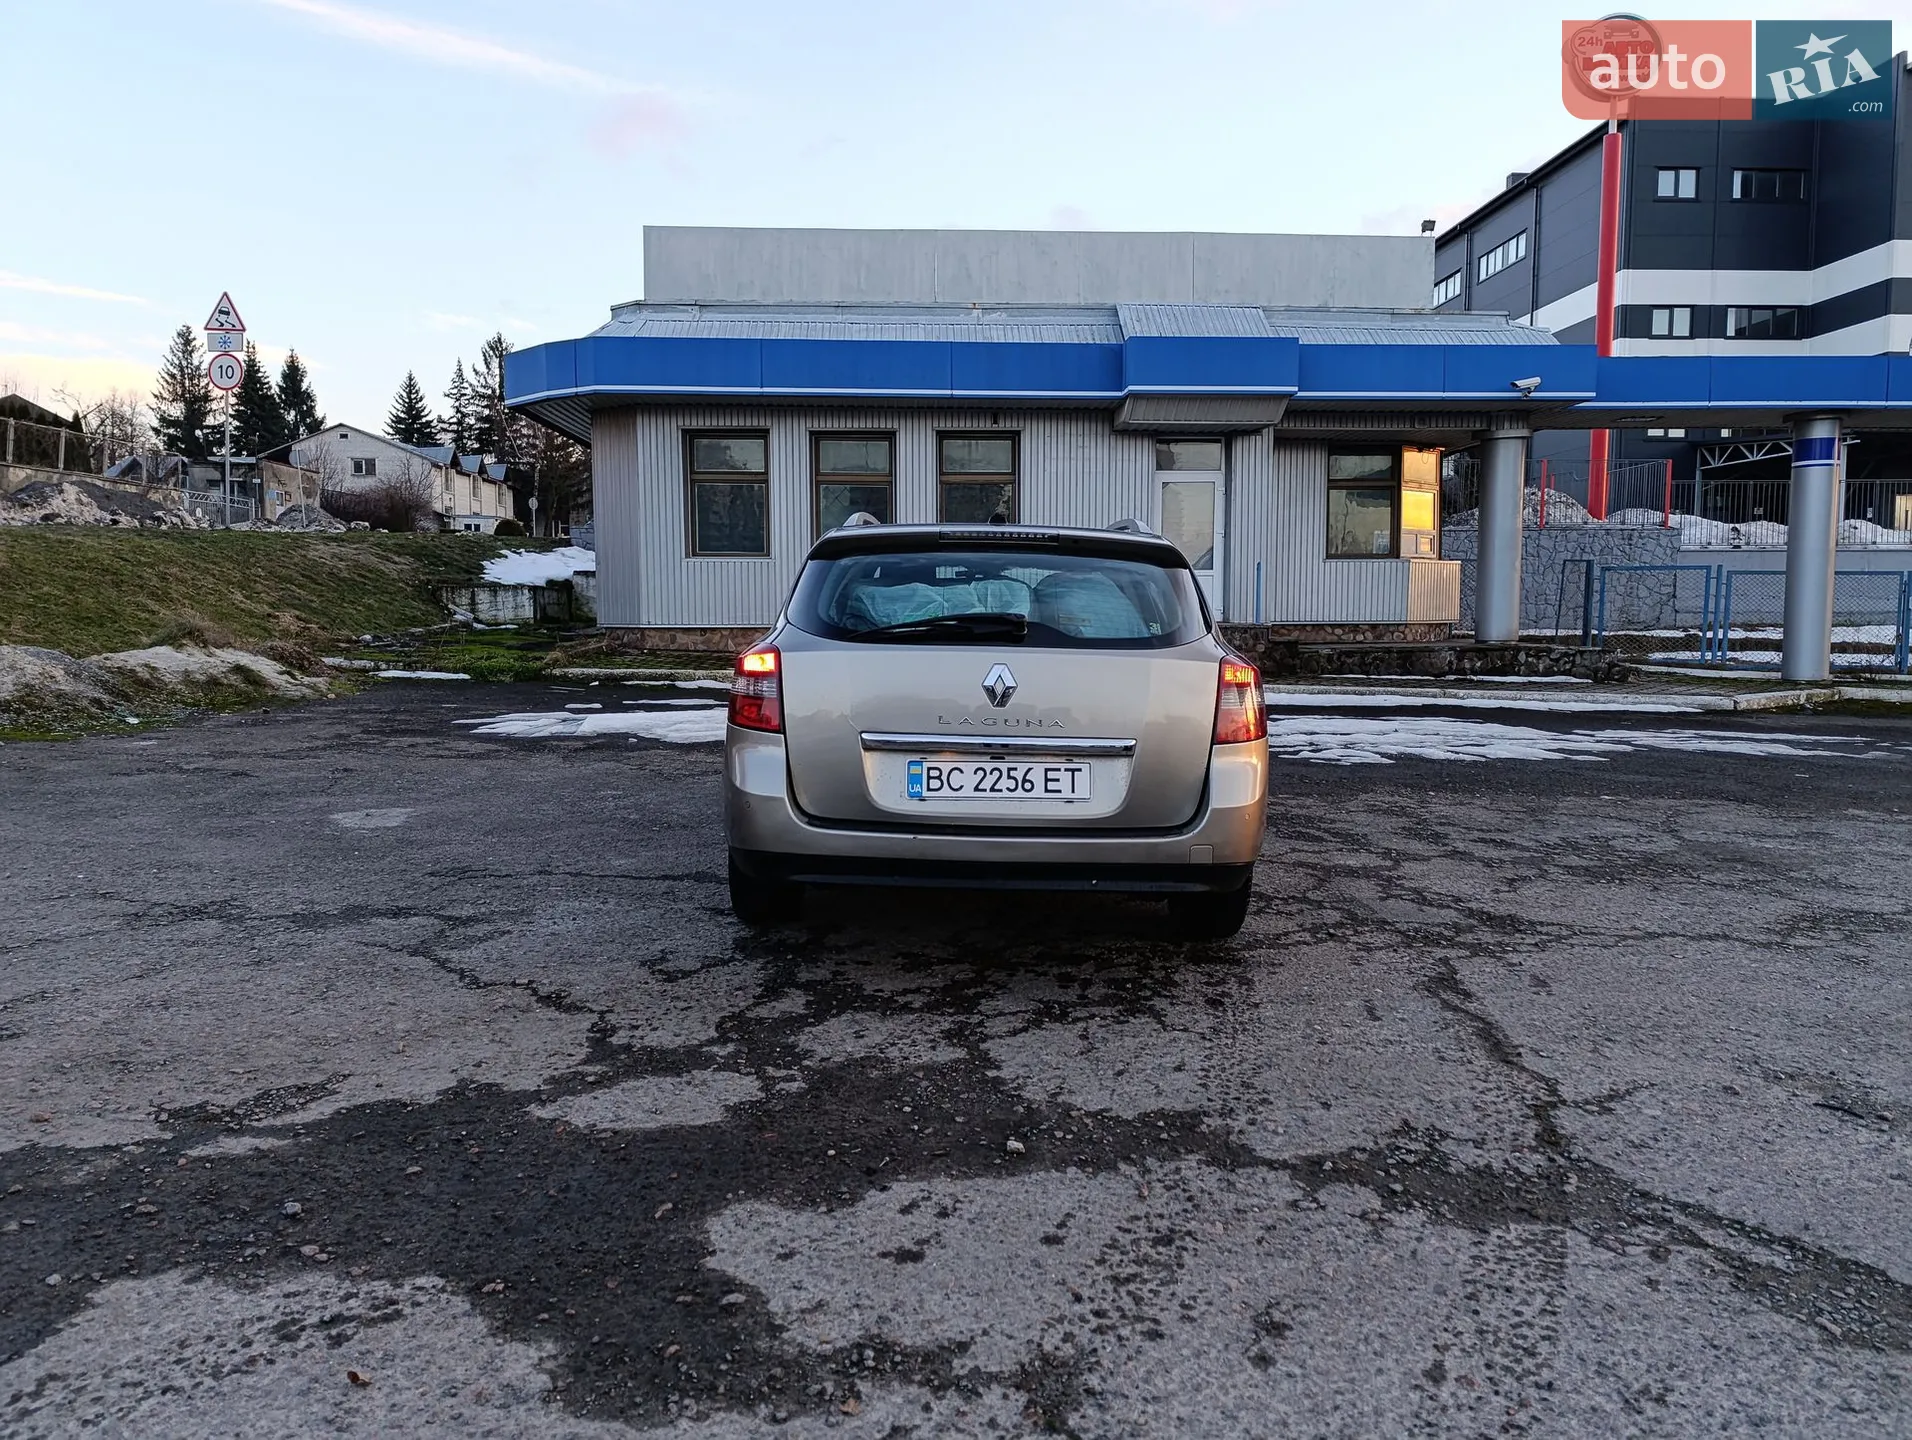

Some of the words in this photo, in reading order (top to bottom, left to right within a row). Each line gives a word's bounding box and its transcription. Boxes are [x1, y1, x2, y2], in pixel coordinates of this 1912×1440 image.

[1578, 36, 1603, 47] 24h
[218, 365, 235, 380] 10
[938, 715, 1066, 729] LAGUNA
[926, 766, 965, 792] BC
[973, 766, 1035, 793] 2256
[1044, 767, 1082, 794] ET
[909, 783, 922, 793] UA
